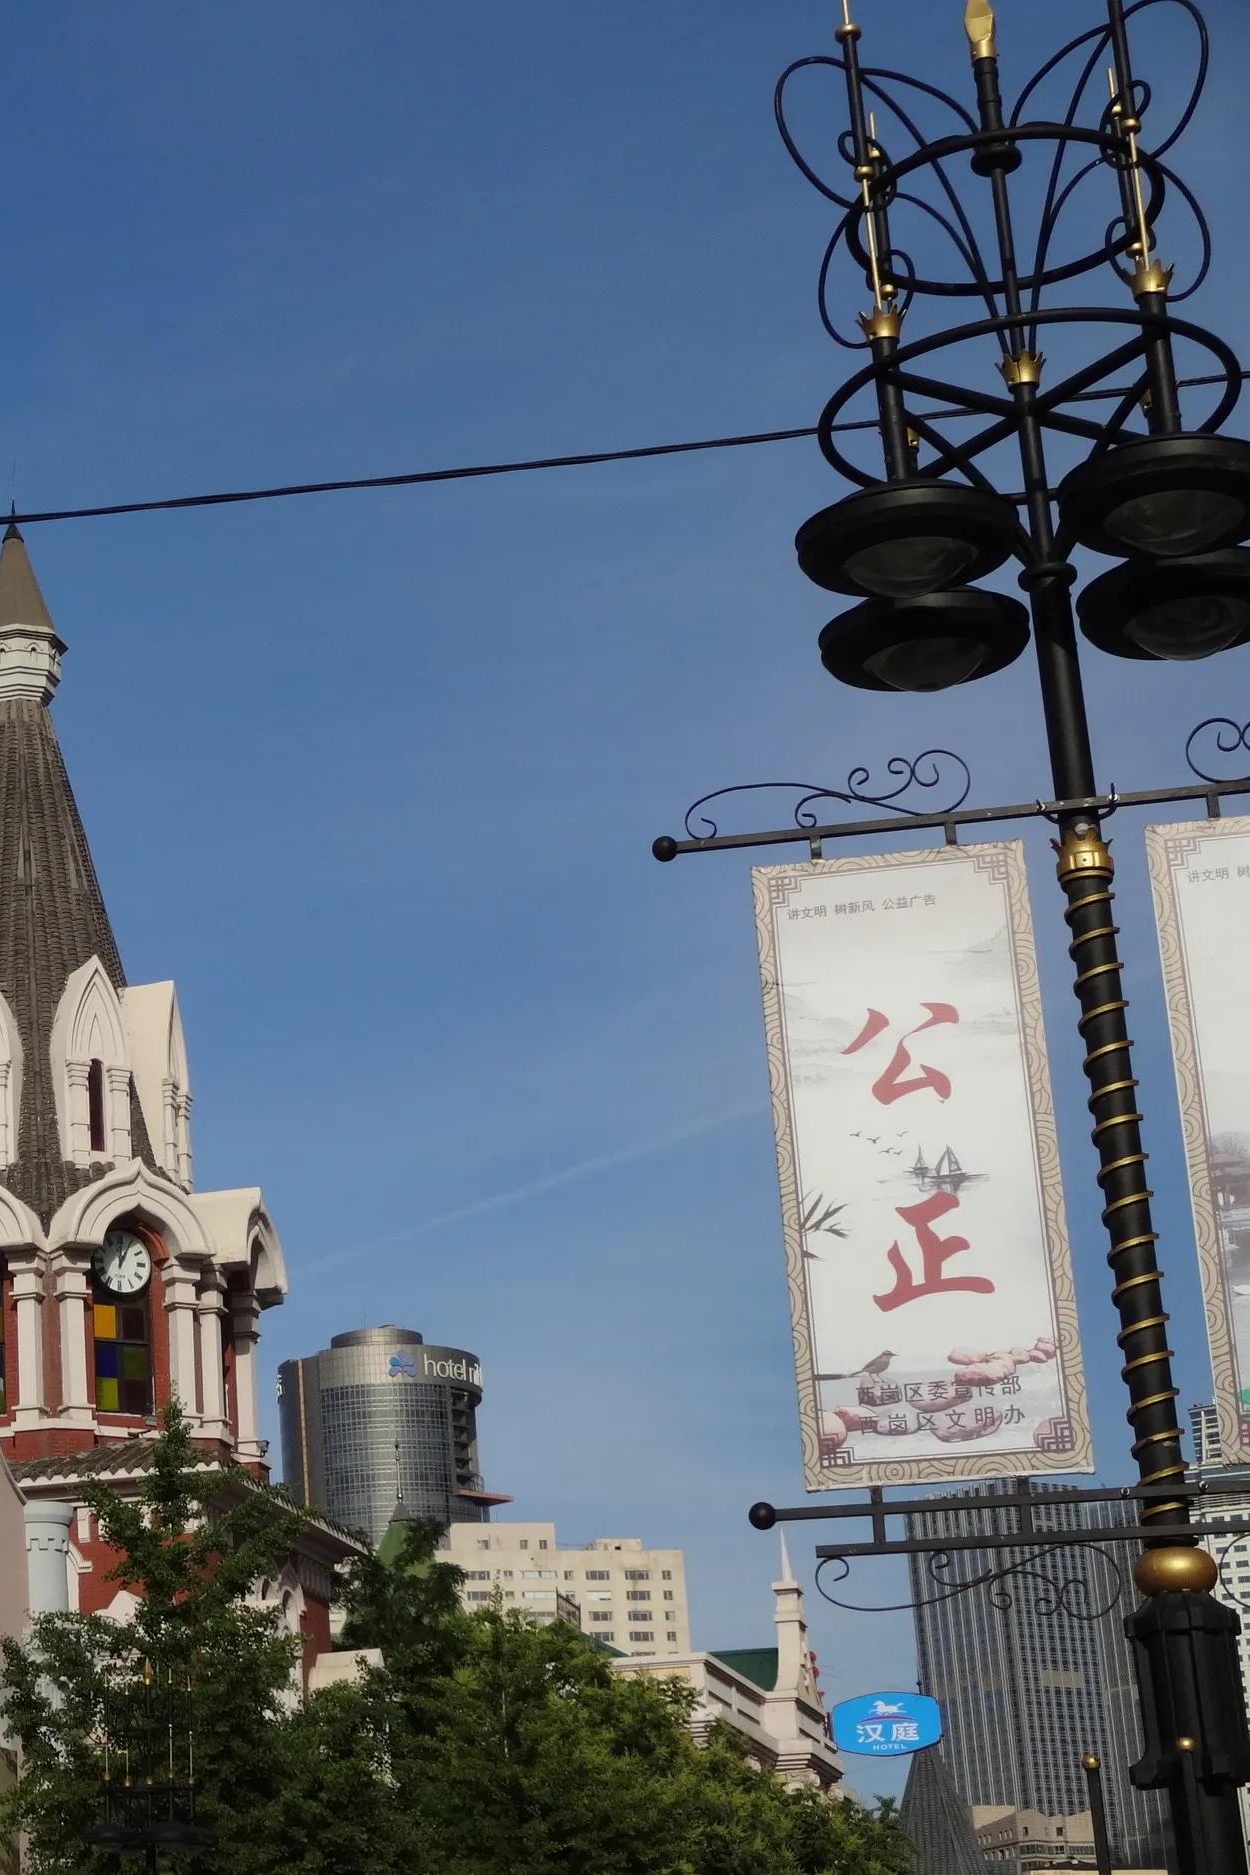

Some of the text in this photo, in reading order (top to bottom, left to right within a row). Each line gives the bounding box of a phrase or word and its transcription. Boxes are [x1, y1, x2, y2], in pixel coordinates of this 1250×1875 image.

[1185, 867, 1229, 883] 讲文明
[786, 893, 937, 921] 讲文明 树新风 公益广告
[424, 1353, 466, 1380] hotel
[858, 1404, 1025, 1435] 西岗区文明办
[856, 1722, 920, 1743] 汉庭
